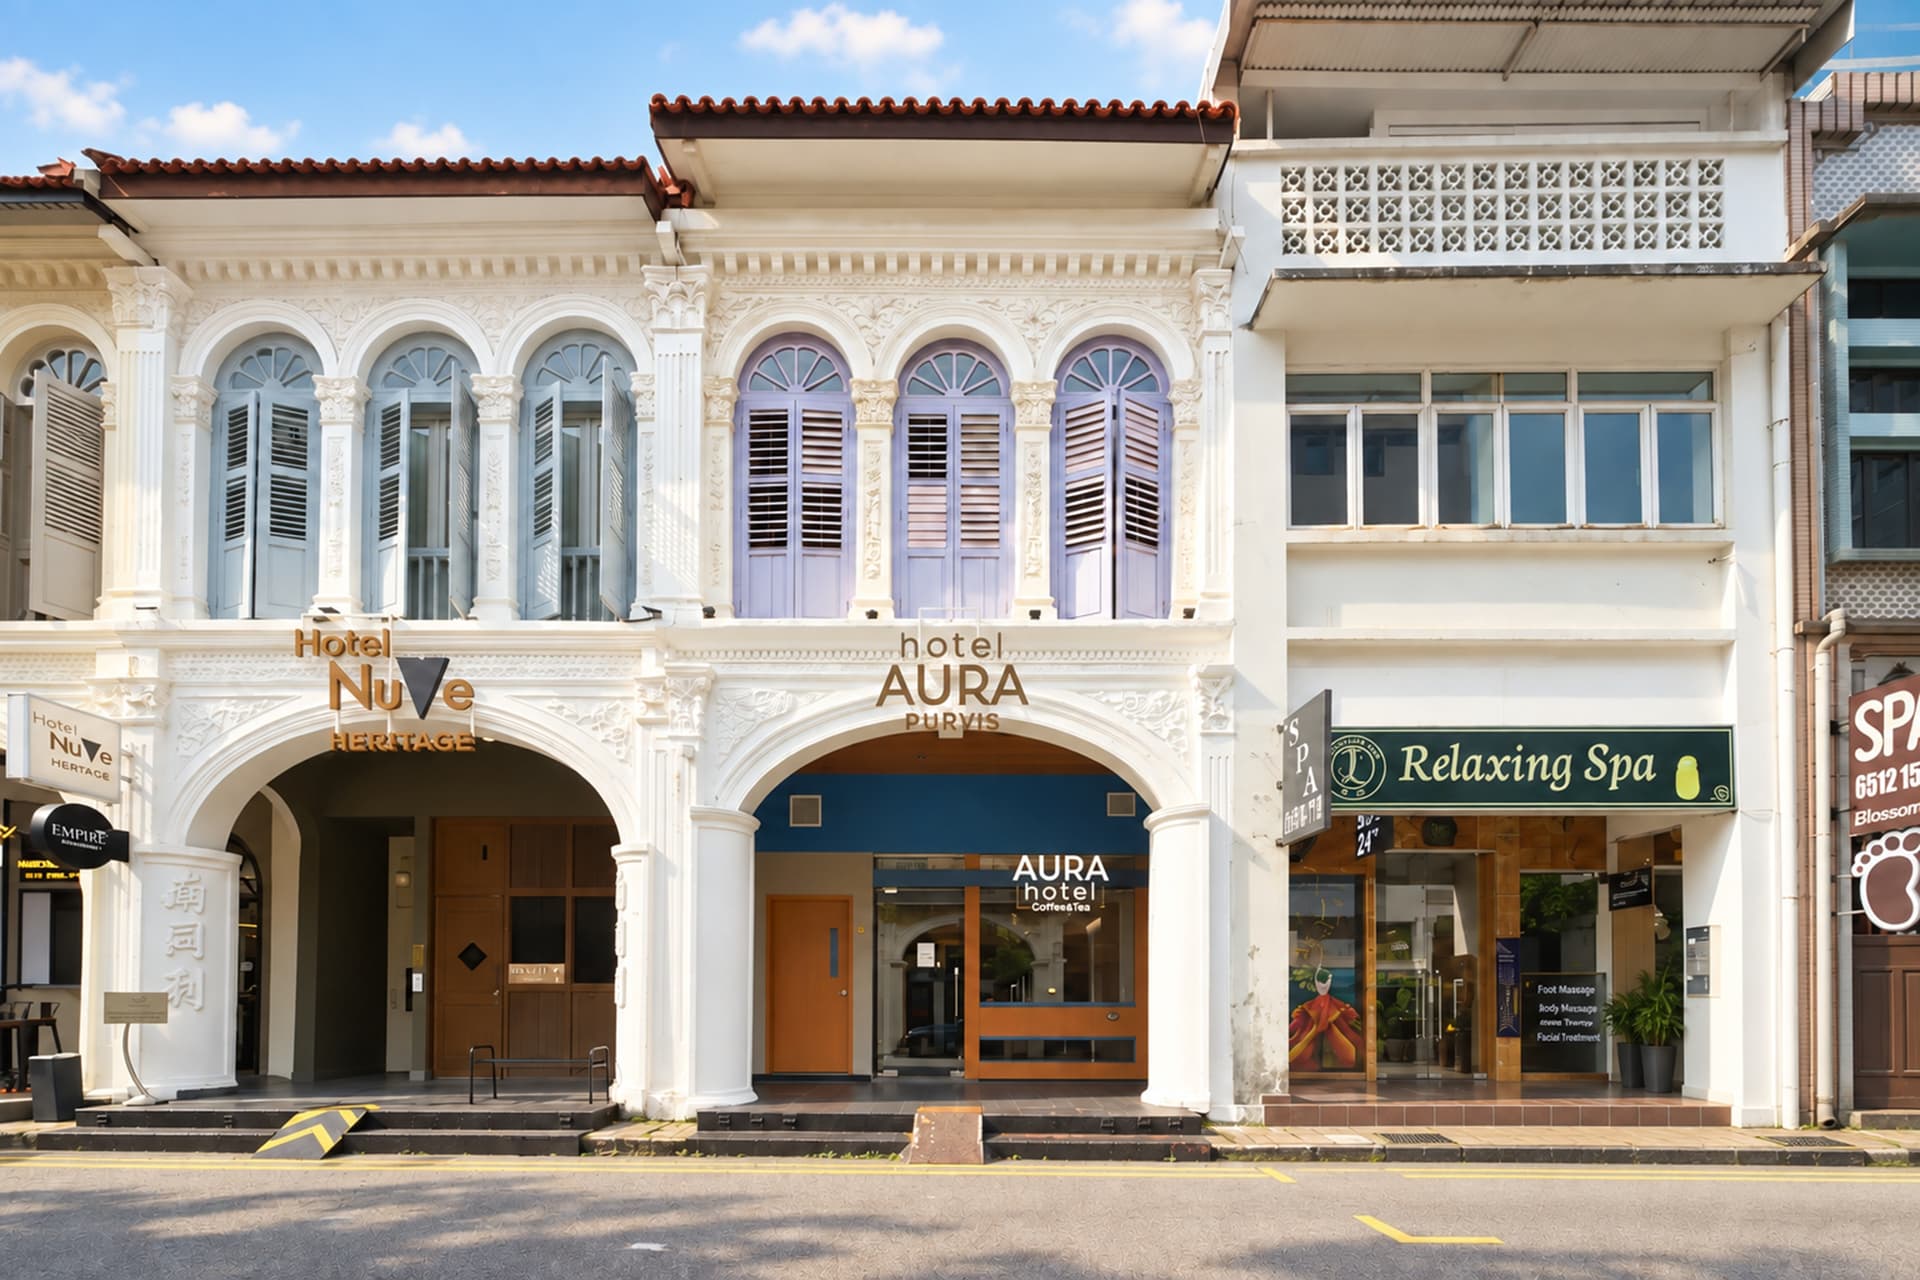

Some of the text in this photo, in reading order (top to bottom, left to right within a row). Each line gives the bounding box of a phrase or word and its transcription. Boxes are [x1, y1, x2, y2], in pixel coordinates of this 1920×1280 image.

[295, 628, 391, 658] Hotel
[901, 632, 1002, 659] hotel
[875, 664, 1029, 706] AURA
[33, 711, 78, 735] Hotel
[906, 712, 1000, 731] PURVIS
[331, 731, 476, 752] HERITAGE
[1398, 742, 1573, 792] Relaxing
[1583, 743, 1656, 791] Spa
[1855, 767, 1898, 800] 6512
[52, 823, 107, 845] EMPIRE
[1012, 854, 1110, 882] AURA
[1024, 882, 1095, 901] hotel
[1031, 902, 1091, 912] Coffee&Tea
[1537, 984, 1596, 997] Foot Massage
